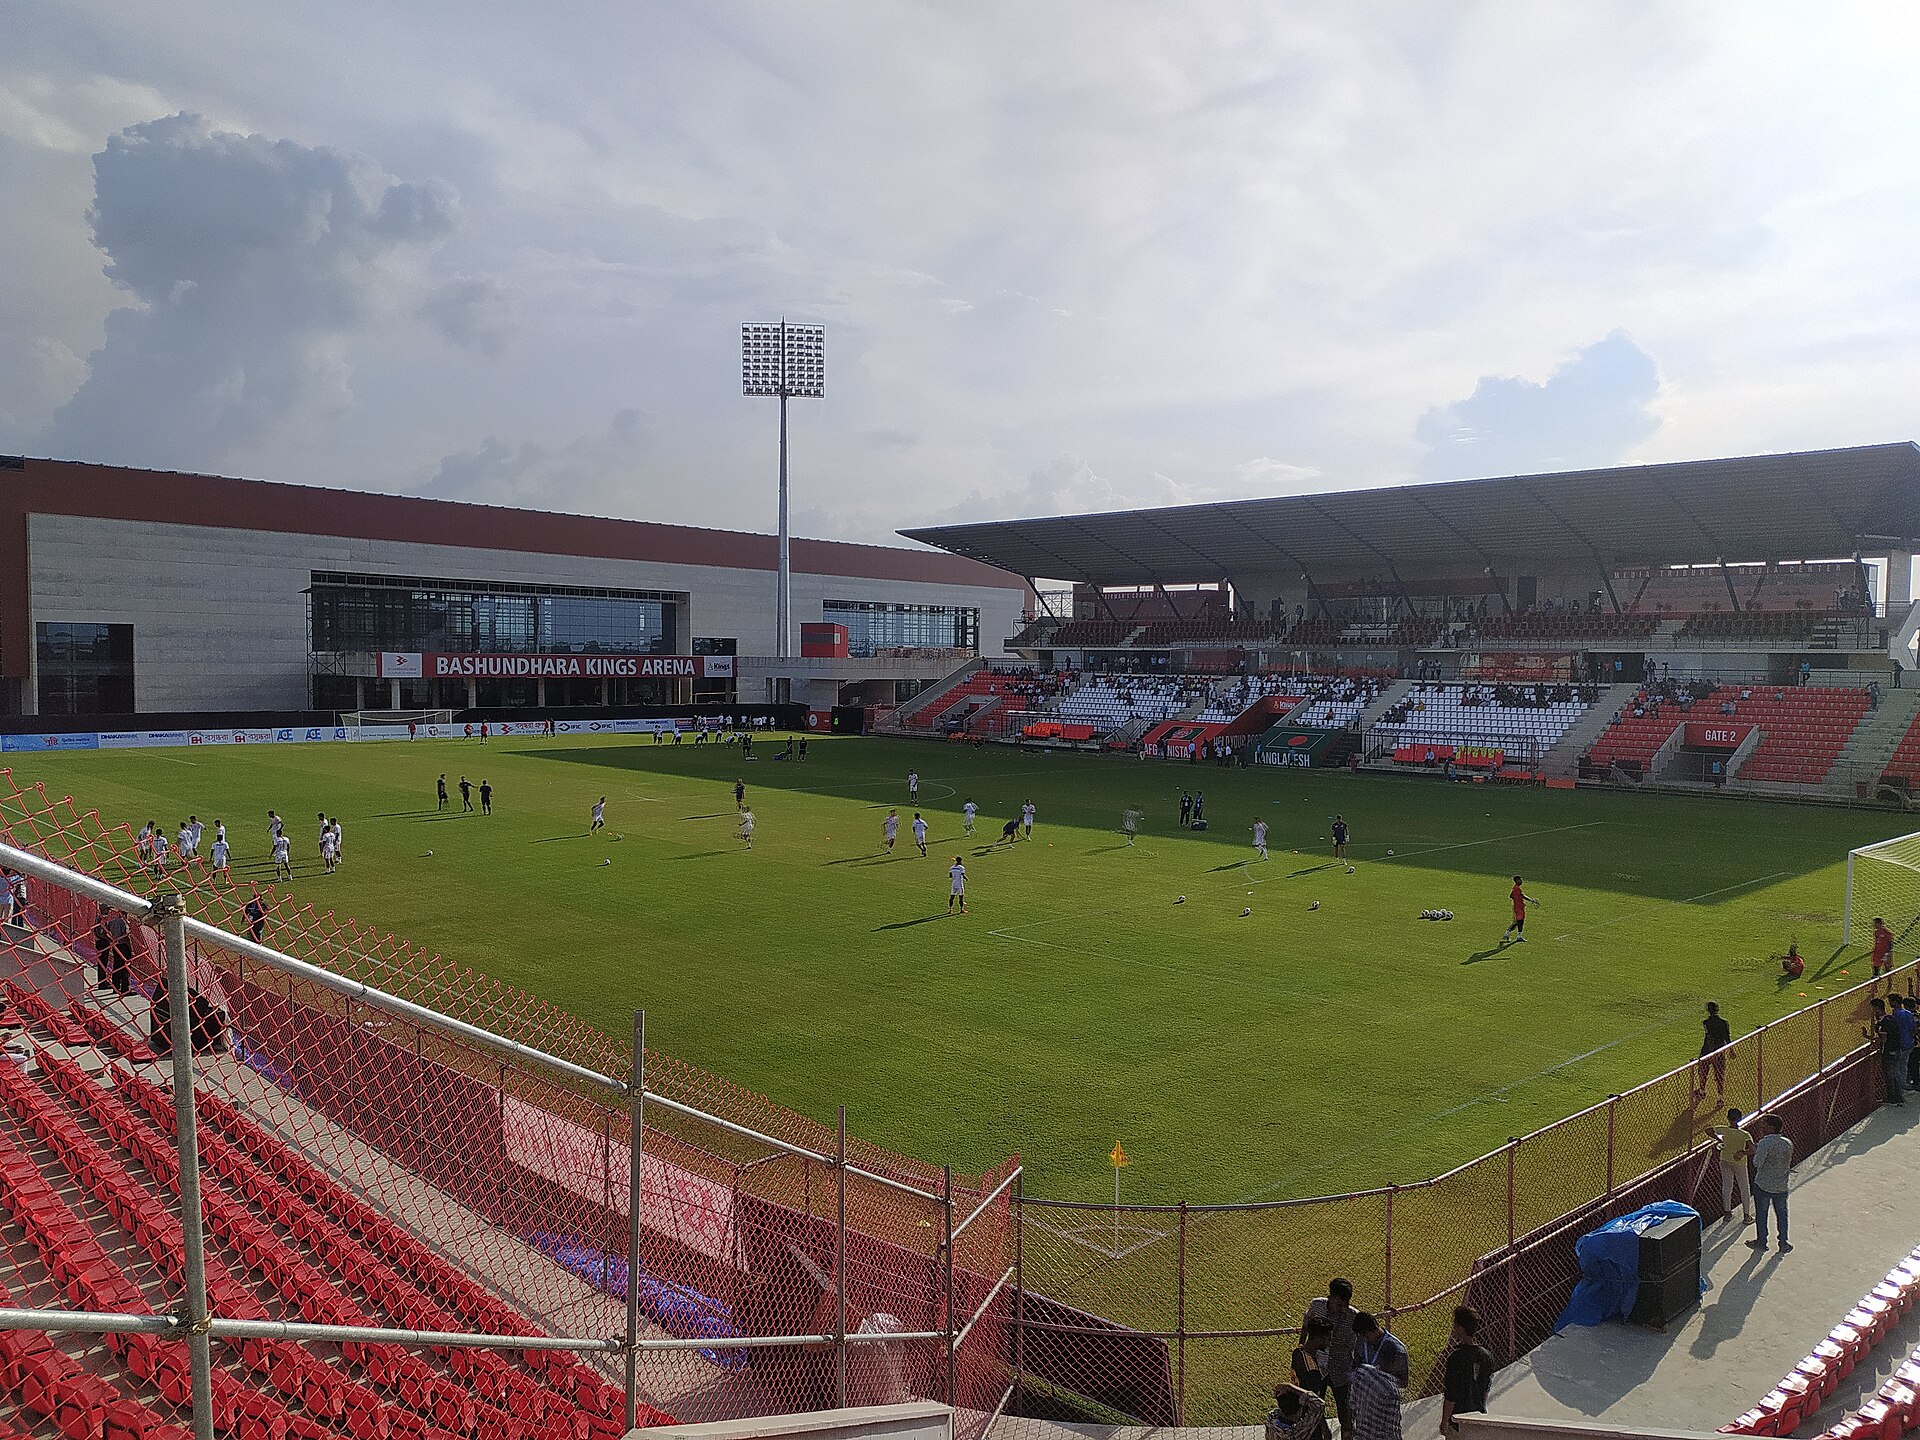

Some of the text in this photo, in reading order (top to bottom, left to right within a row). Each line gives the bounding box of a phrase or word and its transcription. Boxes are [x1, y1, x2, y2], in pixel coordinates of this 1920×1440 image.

[1614, 568, 1713, 579] MEDIA TRIBUNE
[1739, 564, 1841, 575] MEDIA CENTER
[436, 656, 581, 675] BASHUNDHARA
[585, 658, 637, 675] KINGS
[641, 659, 696, 676] ARENA
[1705, 729, 1736, 742] GATE 2
[1144, 743, 1193, 759] AFGNISTA
